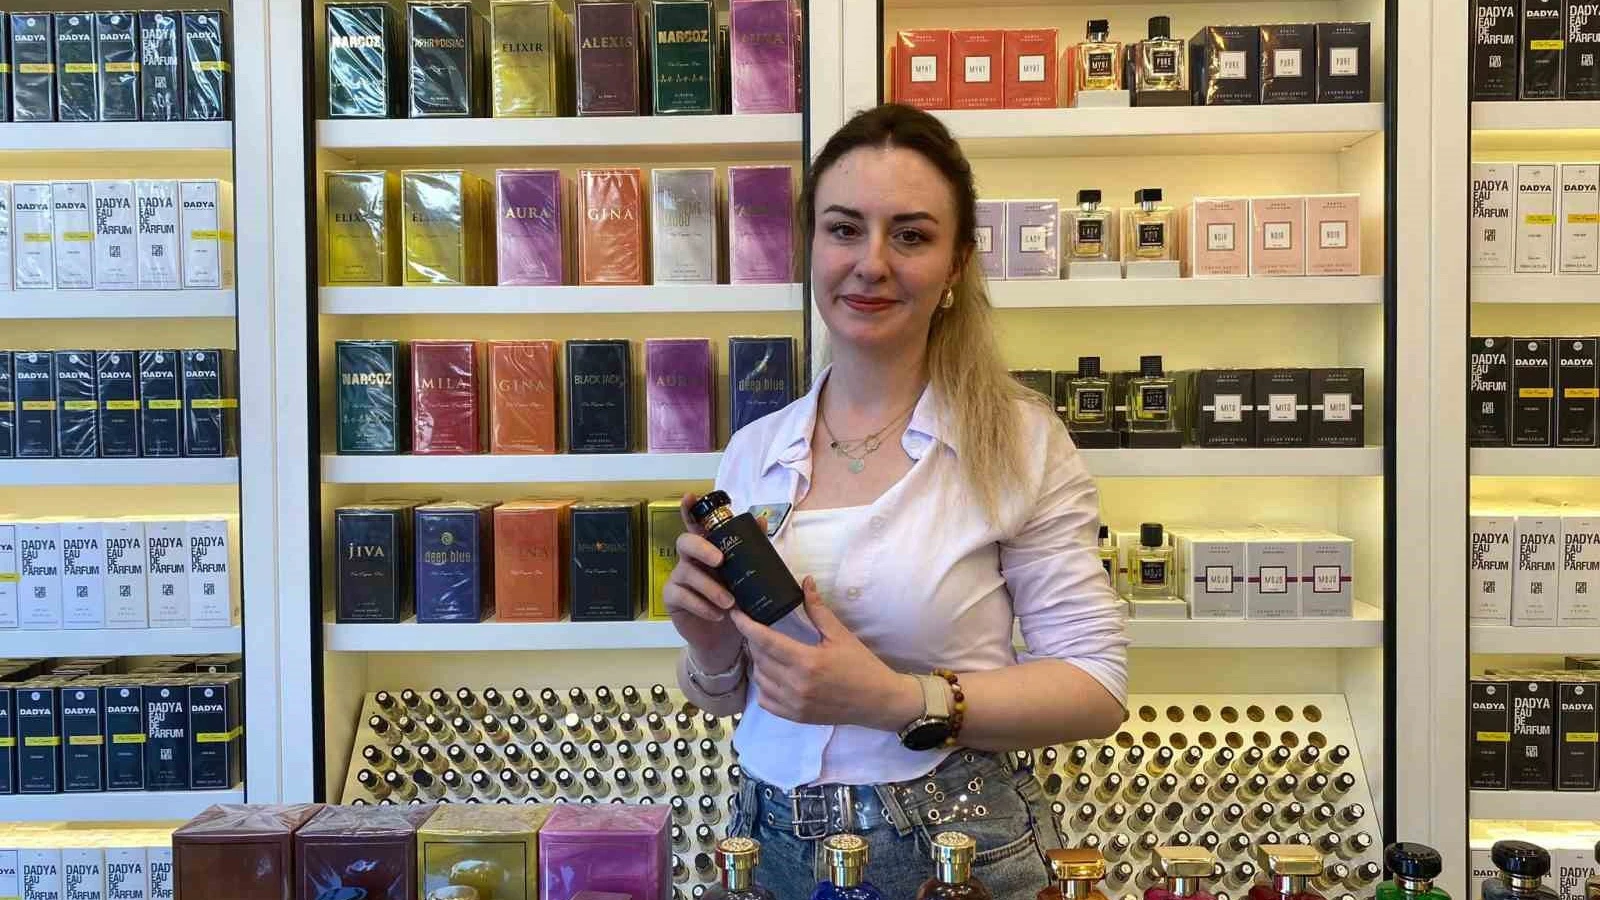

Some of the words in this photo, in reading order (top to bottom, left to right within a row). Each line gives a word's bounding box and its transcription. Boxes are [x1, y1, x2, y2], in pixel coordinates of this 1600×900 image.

[1480, 6, 1514, 17] DADYA
[1480, 17, 1496, 26] EAU
[1570, 16, 1588, 25] EAU
[1479, 26, 1490, 34] DE
[1570, 26, 1581, 34] DE
[15, 34, 46, 42] DADYA
[658, 30, 708, 44] NARCOZ
[1478, 35, 1514, 44] PARFUM
[582, 36, 633, 49] ALEXIS
[502, 43, 544, 52] ELIXIR
[916, 65, 932, 73] MYRT
[970, 66, 986, 74] MYRT
[1474, 180, 1508, 191] DADYA
[1474, 192, 1490, 200] EAU
[55, 202, 87, 210] DADYA
[96, 198, 130, 209] DADYA
[138, 197, 173, 208] DADYA
[1473, 200, 1484, 208] DE
[96, 209, 112, 218] EAU
[139, 208, 156, 216] EAU
[505, 207, 550, 219] AURA
[588, 208, 634, 220] GINA
[1473, 209, 1508, 218] PARFUM
[97, 217, 108, 225] DE
[139, 216, 150, 224] DE
[97, 225, 132, 234] PARFUM
[140, 224, 175, 234] PARFUM
[1472, 354, 1506, 364] DADYA
[1472, 364, 1488, 374] EAU
[342, 372, 392, 386] NARCOZ
[574, 374, 600, 386] BLACK
[422, 378, 465, 390] MILA
[499, 378, 546, 391] GINA
[739, 379, 762, 392] deep
[764, 378, 784, 390] blue
[1471, 382, 1506, 391] PARFUM
[150, 538, 183, 548] DADYA
[191, 537, 224, 547] DADYA
[1473, 533, 1508, 544] DADYA
[1520, 534, 1556, 544] DADYA
[1565, 534, 1600, 544] DADYA
[22, 540, 56, 550] DADYA
[64, 539, 98, 550] DADYA
[106, 538, 140, 549] DADYA
[1472, 544, 1490, 552] EAU
[107, 549, 123, 557] EAU
[150, 548, 166, 556] EAU
[191, 547, 207, 556] EAU
[1520, 545, 1537, 553] EAU
[1565, 545, 1582, 553] EAU
[22, 550, 38, 558] EAU
[64, 550, 80, 558] EAU
[425, 551, 446, 564] deep
[450, 551, 472, 563] blue
[1472, 553, 1484, 561] DE
[22, 558, 33, 566] DE
[107, 557, 118, 565] DE
[150, 556, 161, 564] DE
[192, 556, 202, 564] DE
[108, 565, 142, 574] PARFUM
[150, 564, 184, 573] PARFUM
[192, 564, 226, 572] PARFUM
[1472, 561, 1508, 570] PARFUM
[1520, 562, 1555, 570] PARFUM
[1564, 562, 1600, 570] PARFUM
[22, 566, 57, 576] PARFUM
[64, 566, 100, 575] PARFUM
[1211, 574, 1230, 584] MOJO
[1264, 575, 1282, 585] MOJO
[1318, 574, 1336, 584] MOJO
[149, 702, 182, 712] DADYA
[1514, 698, 1550, 708] DADYA
[20, 708, 51, 716] DADYA
[192, 704, 224, 712] DADYA
[1515, 708, 1532, 717] EAU
[149, 712, 166, 721] EAU
[1514, 717, 1526, 725] DE
[149, 721, 160, 729] DE
[149, 729, 184, 738] PARFUM
[1514, 726, 1550, 734] PARFUM
[24, 865, 57, 875] DADYA
[66, 865, 99, 874] DADYA
[108, 864, 142, 873] DADYA
[152, 863, 170, 873] DAD
[1560, 867, 1596, 877] DADYA
[66, 875, 82, 883] EAU
[152, 874, 167, 882] EAU
[1560, 878, 1578, 886] EAU
[24, 892, 58, 900] PARFUM
[66, 891, 100, 900] PARFUM
[109, 890, 143, 899] PARFUM
[152, 890, 172, 898] PARF
